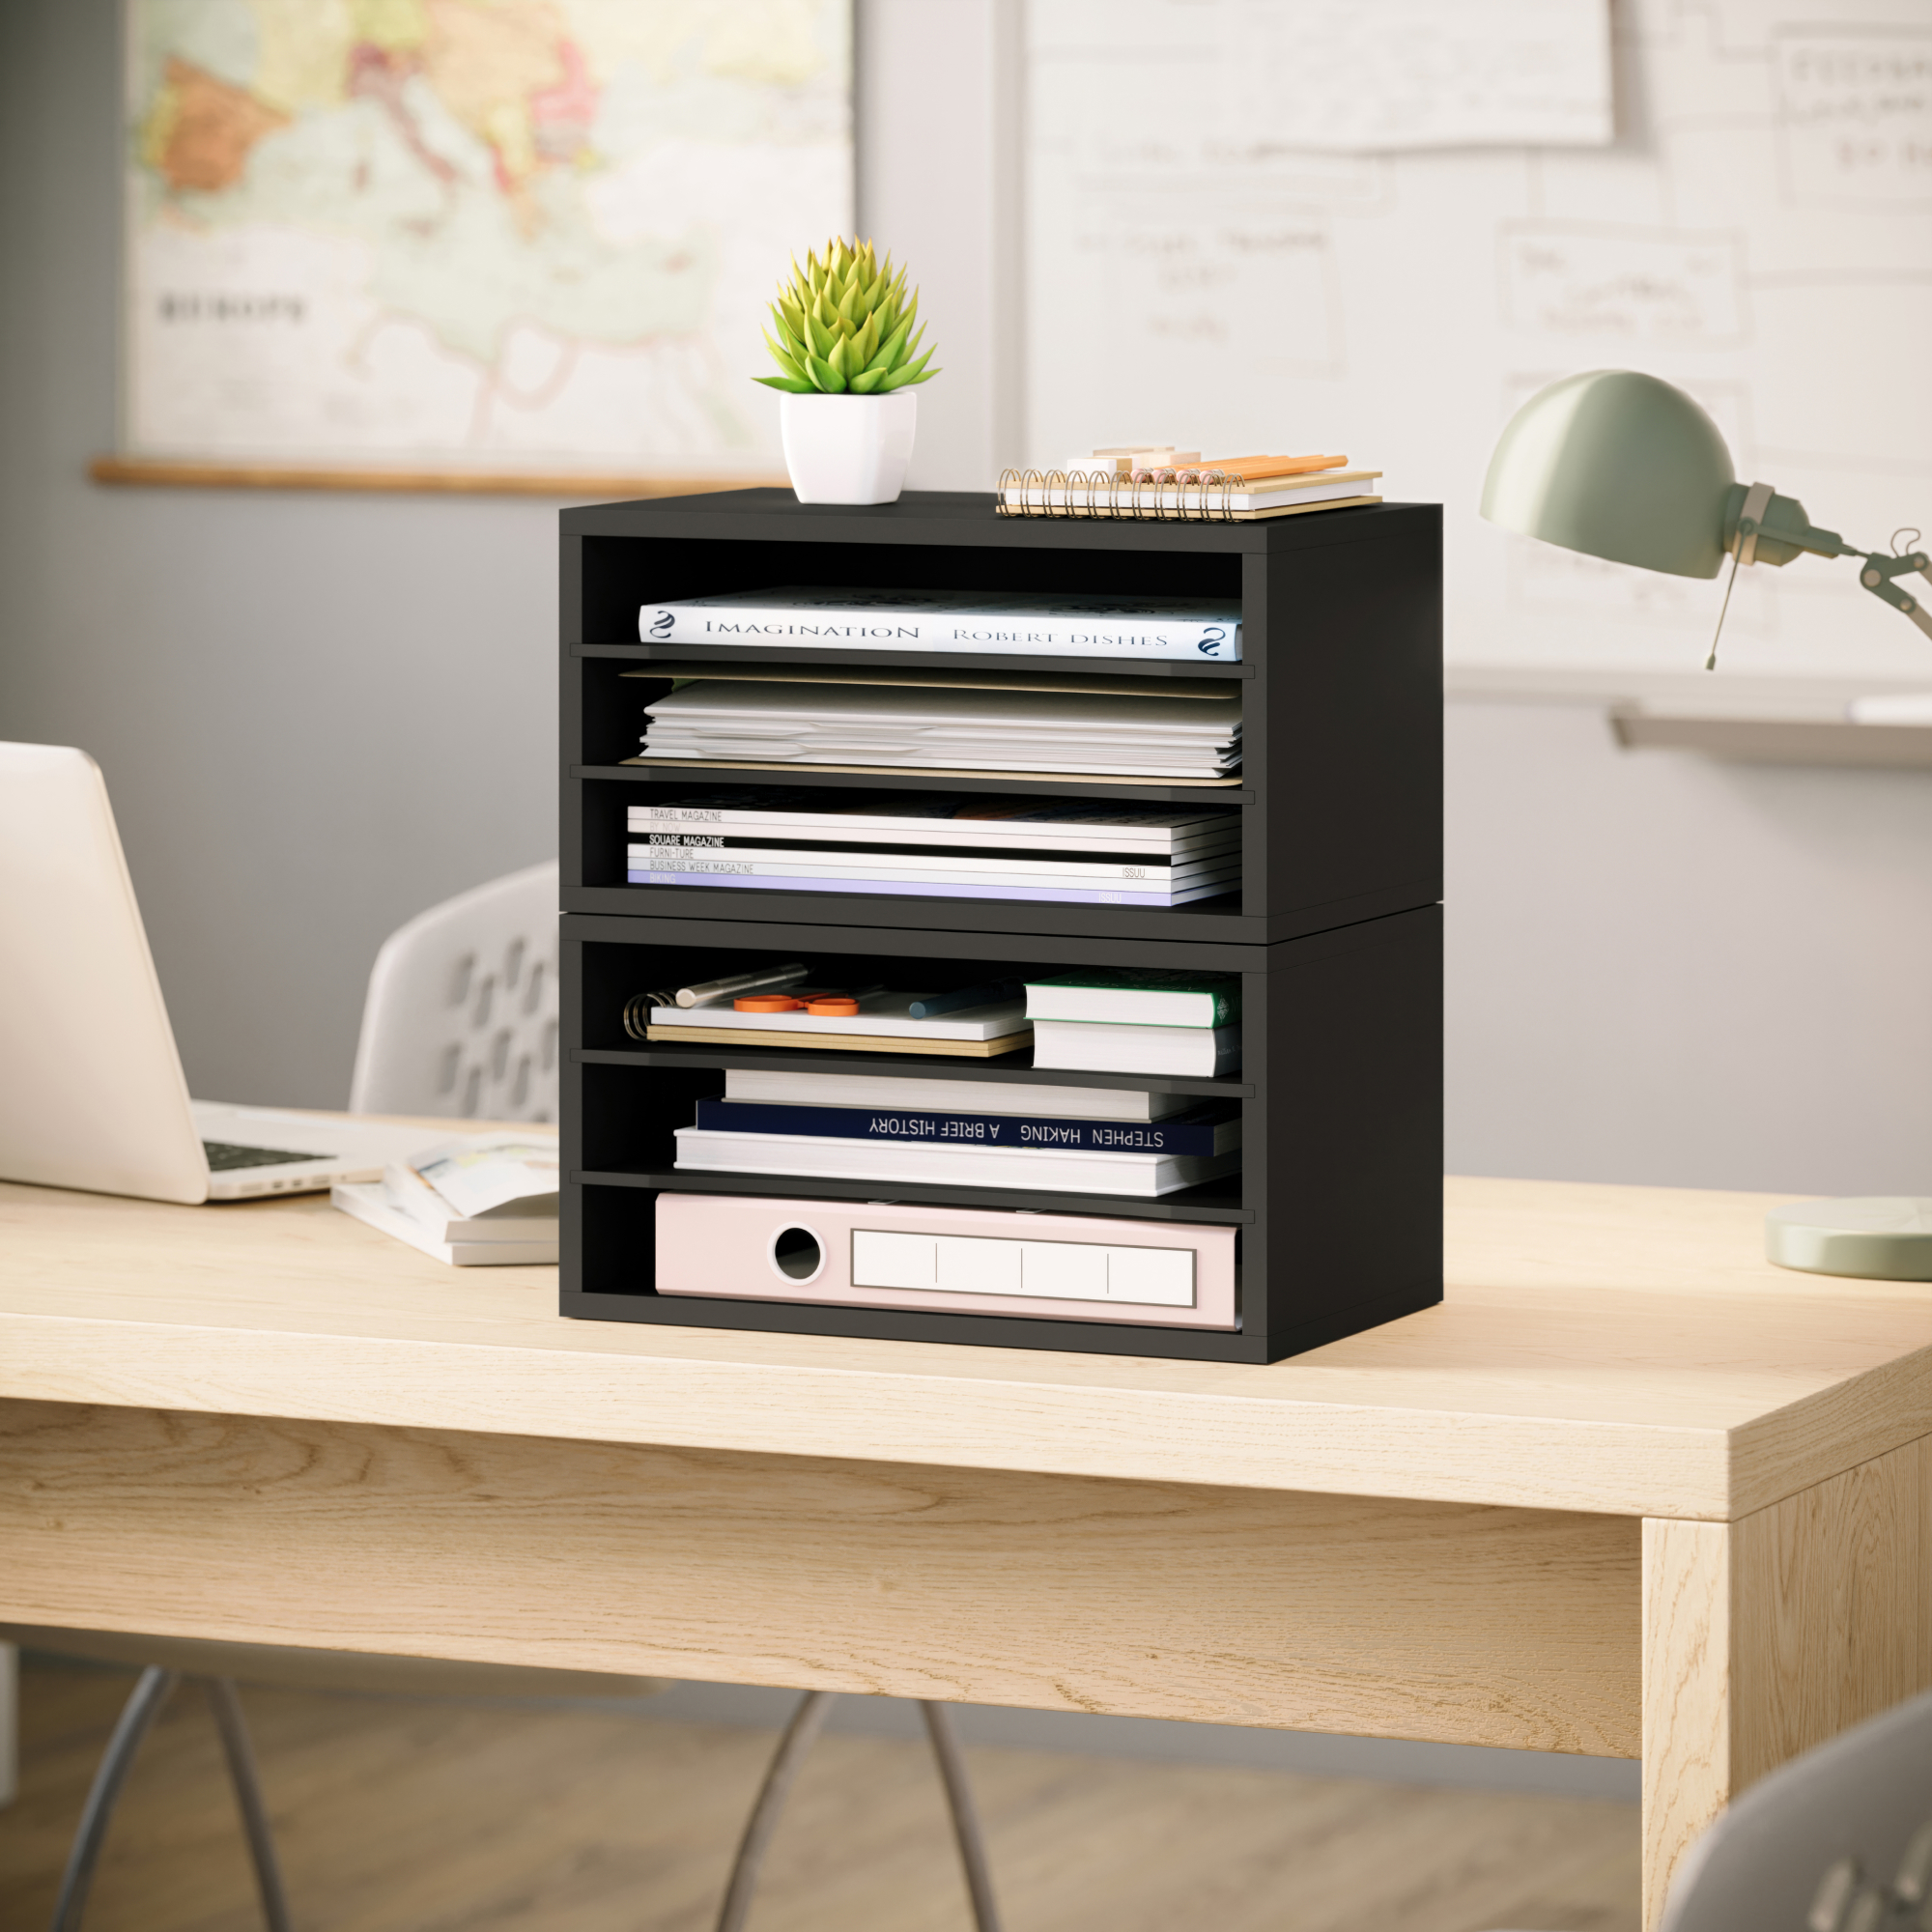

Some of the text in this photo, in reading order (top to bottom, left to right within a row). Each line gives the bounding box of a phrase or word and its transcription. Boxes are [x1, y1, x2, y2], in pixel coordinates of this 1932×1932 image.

[705, 620, 920, 639] IMAGINATION
[952, 629, 1168, 646] ROBERT DISHES
[649, 809, 723, 822] TRAVEL MAGAZINE
[650, 821, 681, 833] BY NOW
[649, 834, 724, 847] SQUARE MAGAZINE
[649, 847, 694, 859] FURNI-TURE
[649, 860, 753, 874] BUSINESS WEEK MAGAZINE
[1122, 867, 1146, 878] ISSUU
[649, 872, 676, 884] BIKING
[1098, 893, 1122, 903] ISSUU
[869, 1117, 1000, 1139] A BRIEF HISTORY
[1020, 1124, 1164, 1148] STEPHEN HAKING
